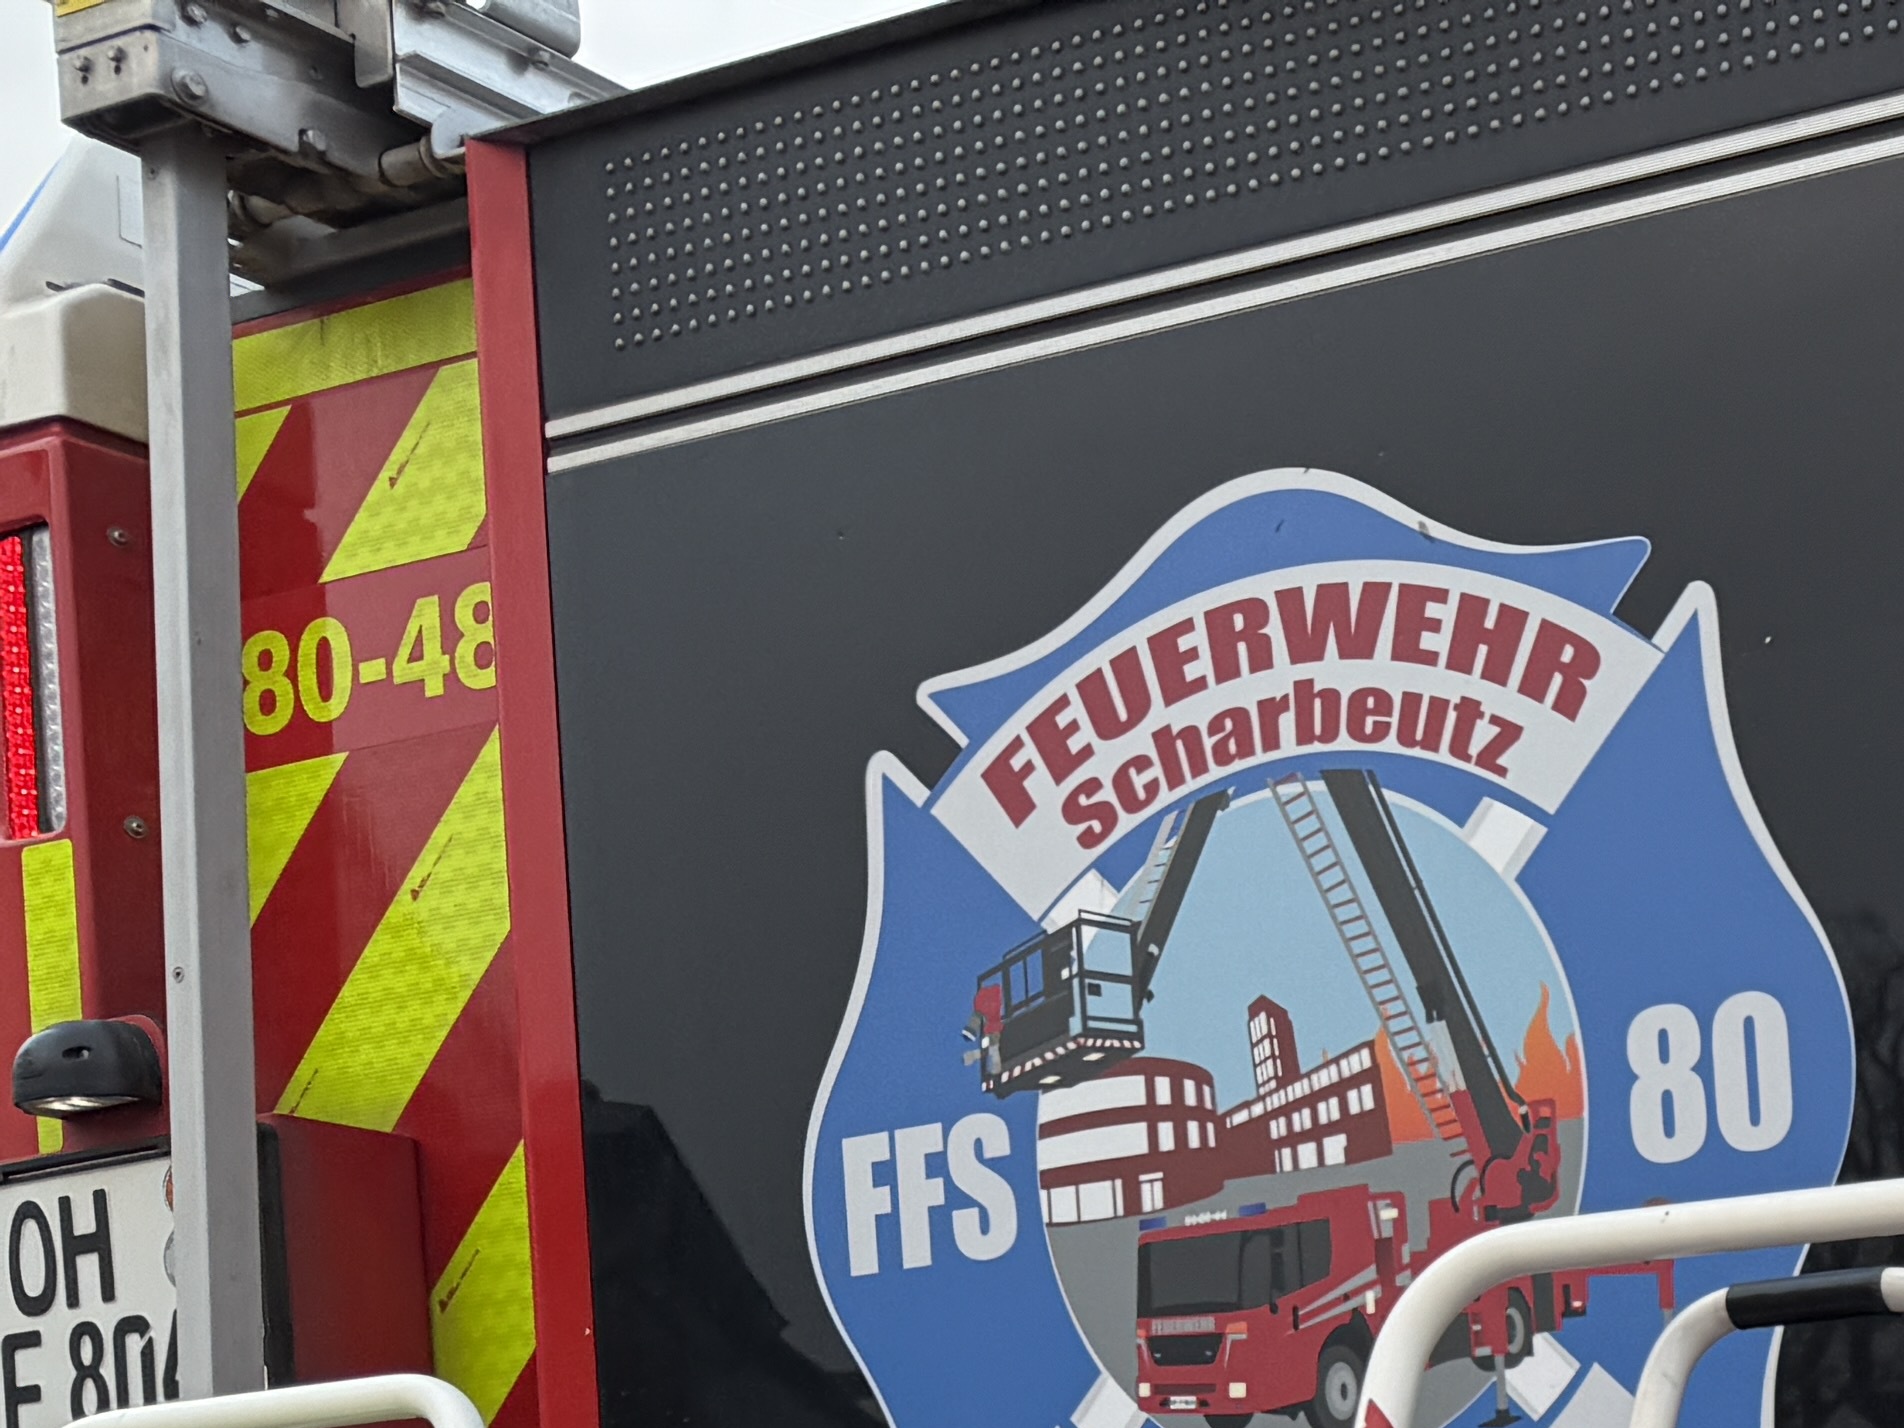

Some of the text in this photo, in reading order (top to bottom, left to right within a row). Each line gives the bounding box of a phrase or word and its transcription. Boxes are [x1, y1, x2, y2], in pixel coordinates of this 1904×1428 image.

[242, 582, 496, 736] 80-48
[980, 580, 1602, 829] FEUERWEHR
[1061, 679, 1525, 850] Scharbeutz
[1626, 990, 1793, 1164] 80
[9, 1188, 115, 1317] OH
[843, 1113, 1018, 1276] FFS
